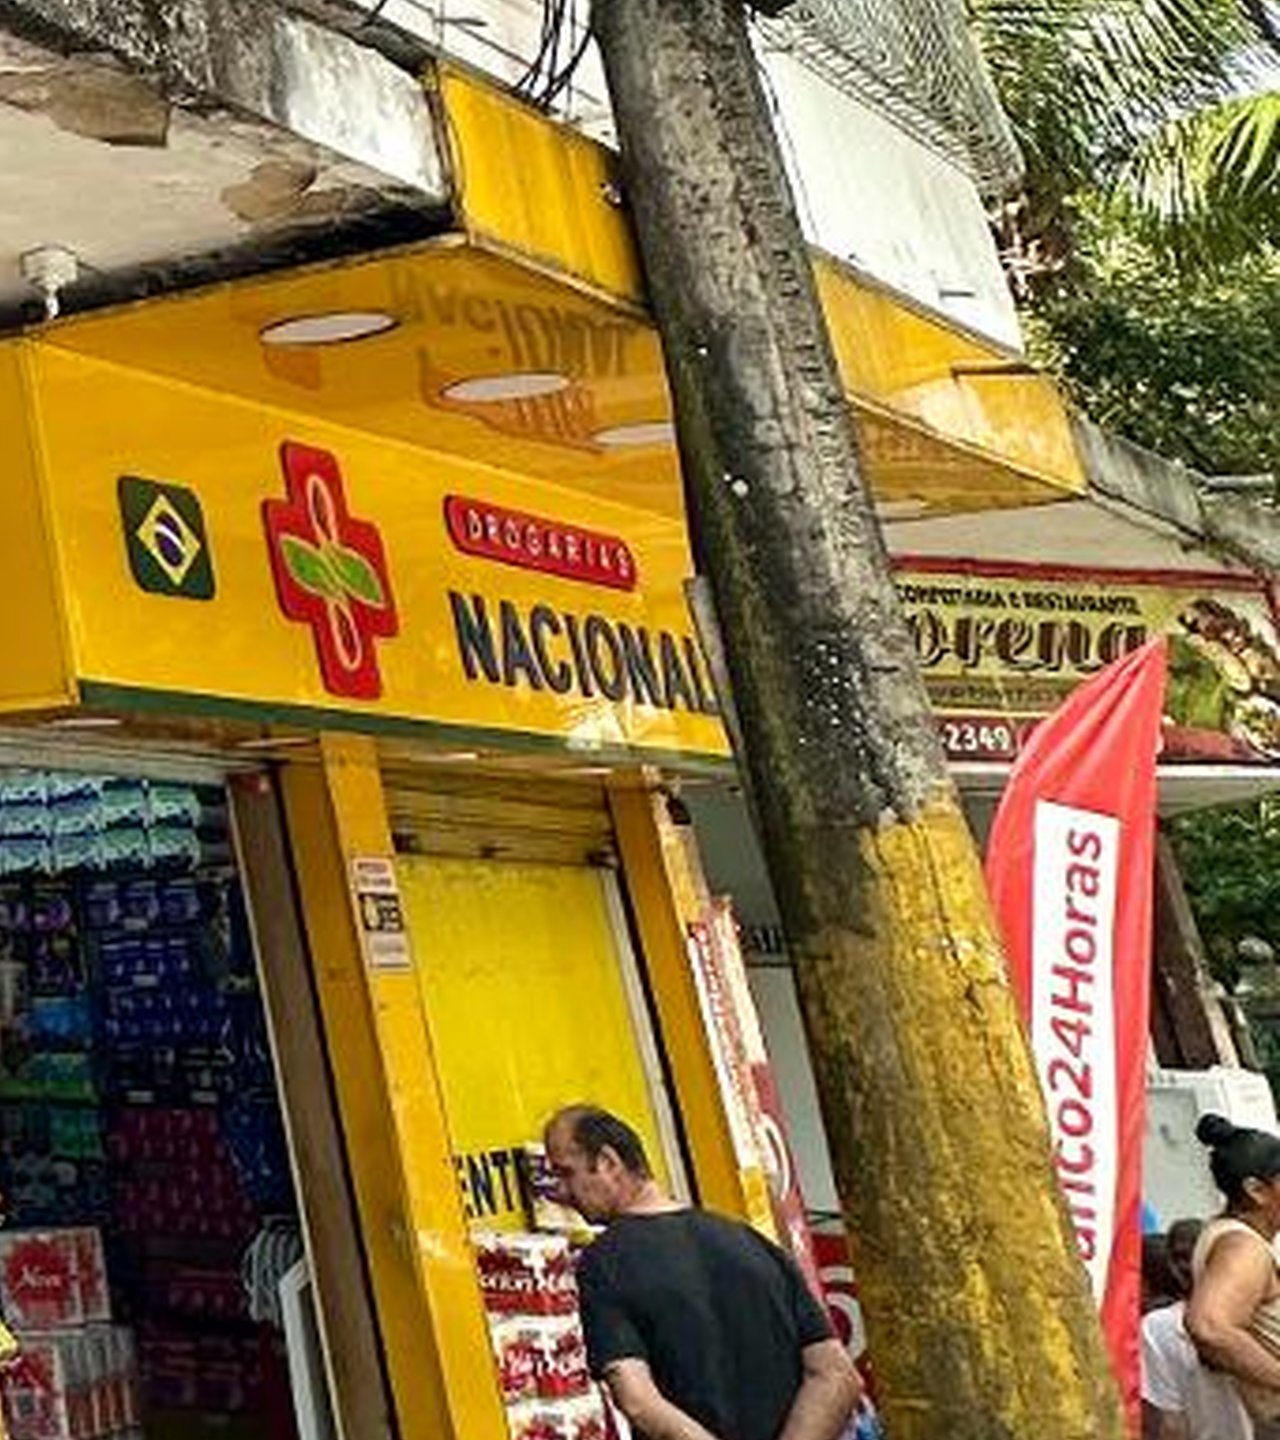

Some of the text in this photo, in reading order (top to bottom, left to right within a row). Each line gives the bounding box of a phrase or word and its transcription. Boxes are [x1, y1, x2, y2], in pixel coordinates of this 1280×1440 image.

[464, 507, 634, 580] DROGARIAS
[448, 590, 721, 716] NACIONAL
[906, 606, 1148, 673] orena
[1046, 826, 1102, 1262] anco24Horas
